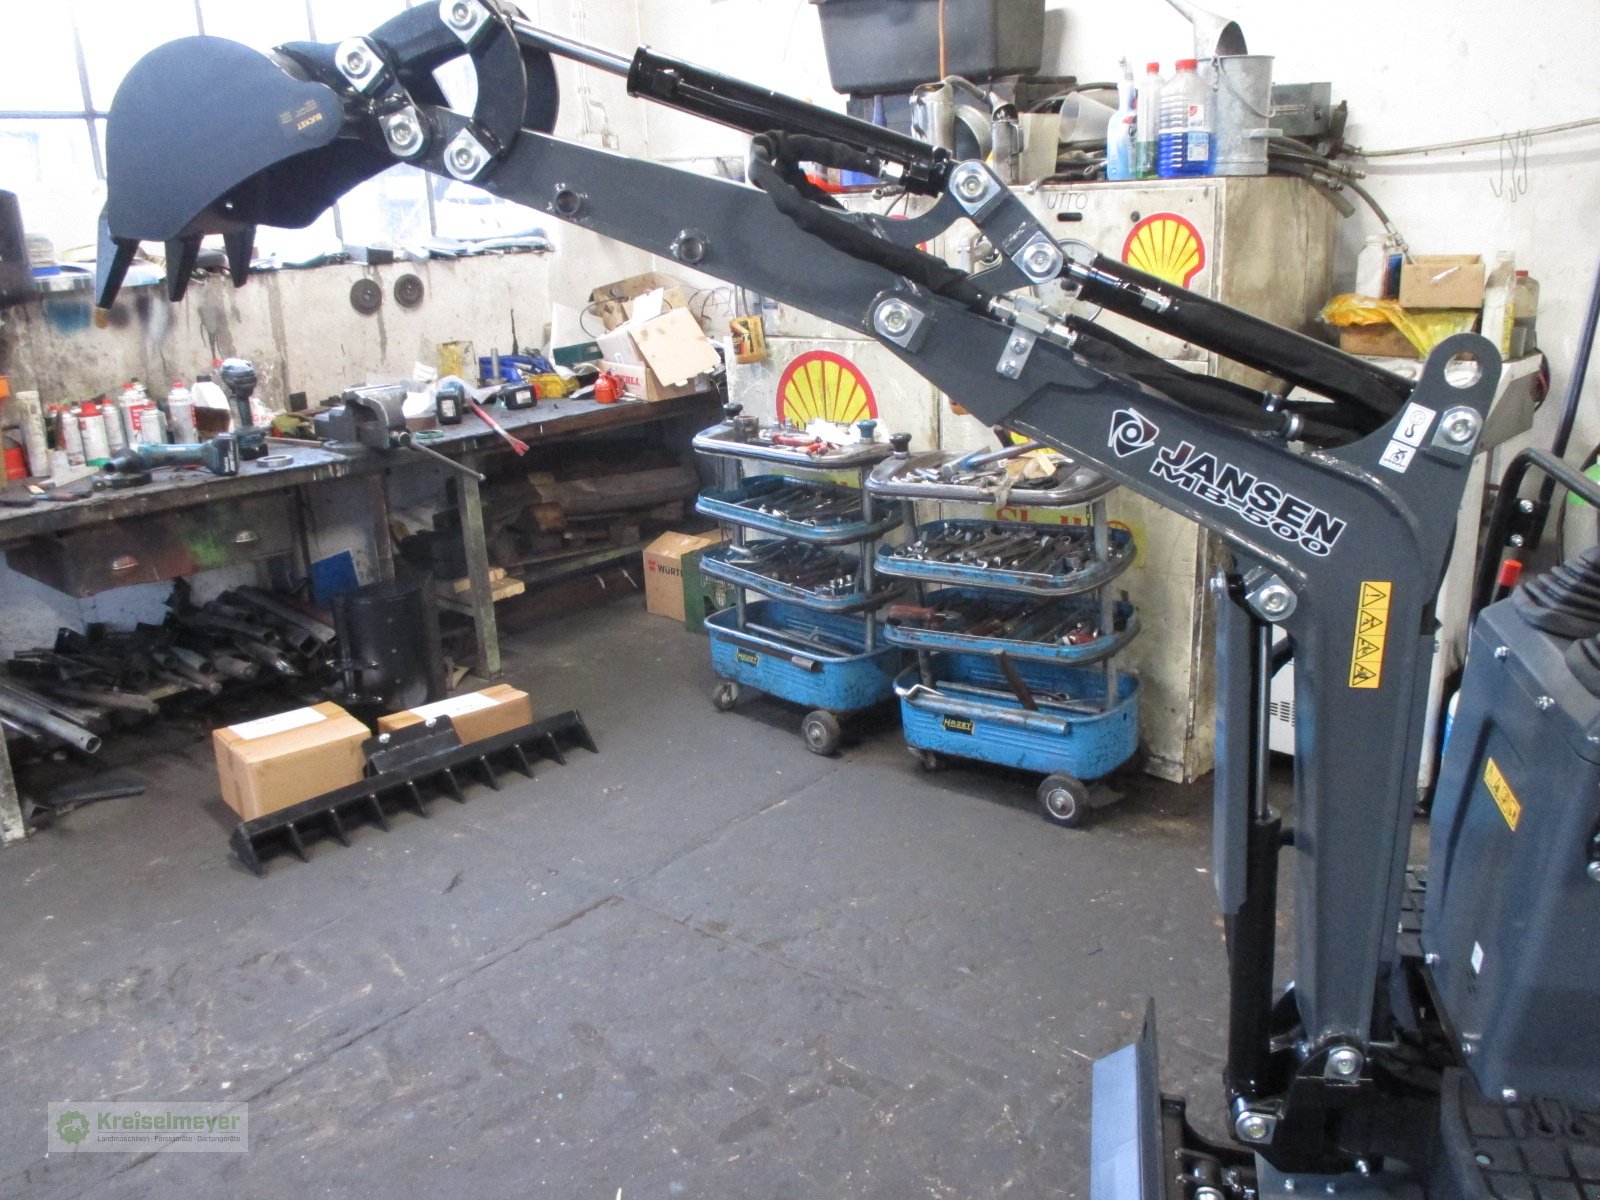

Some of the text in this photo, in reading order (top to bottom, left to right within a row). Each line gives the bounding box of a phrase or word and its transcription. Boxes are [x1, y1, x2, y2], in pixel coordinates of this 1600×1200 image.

[1047, 192, 1088, 210] UTTO
[1149, 457, 1331, 557] MB-500
[1158, 440, 1347, 547] JANSEN
[943, 717, 973, 731] HAZET
